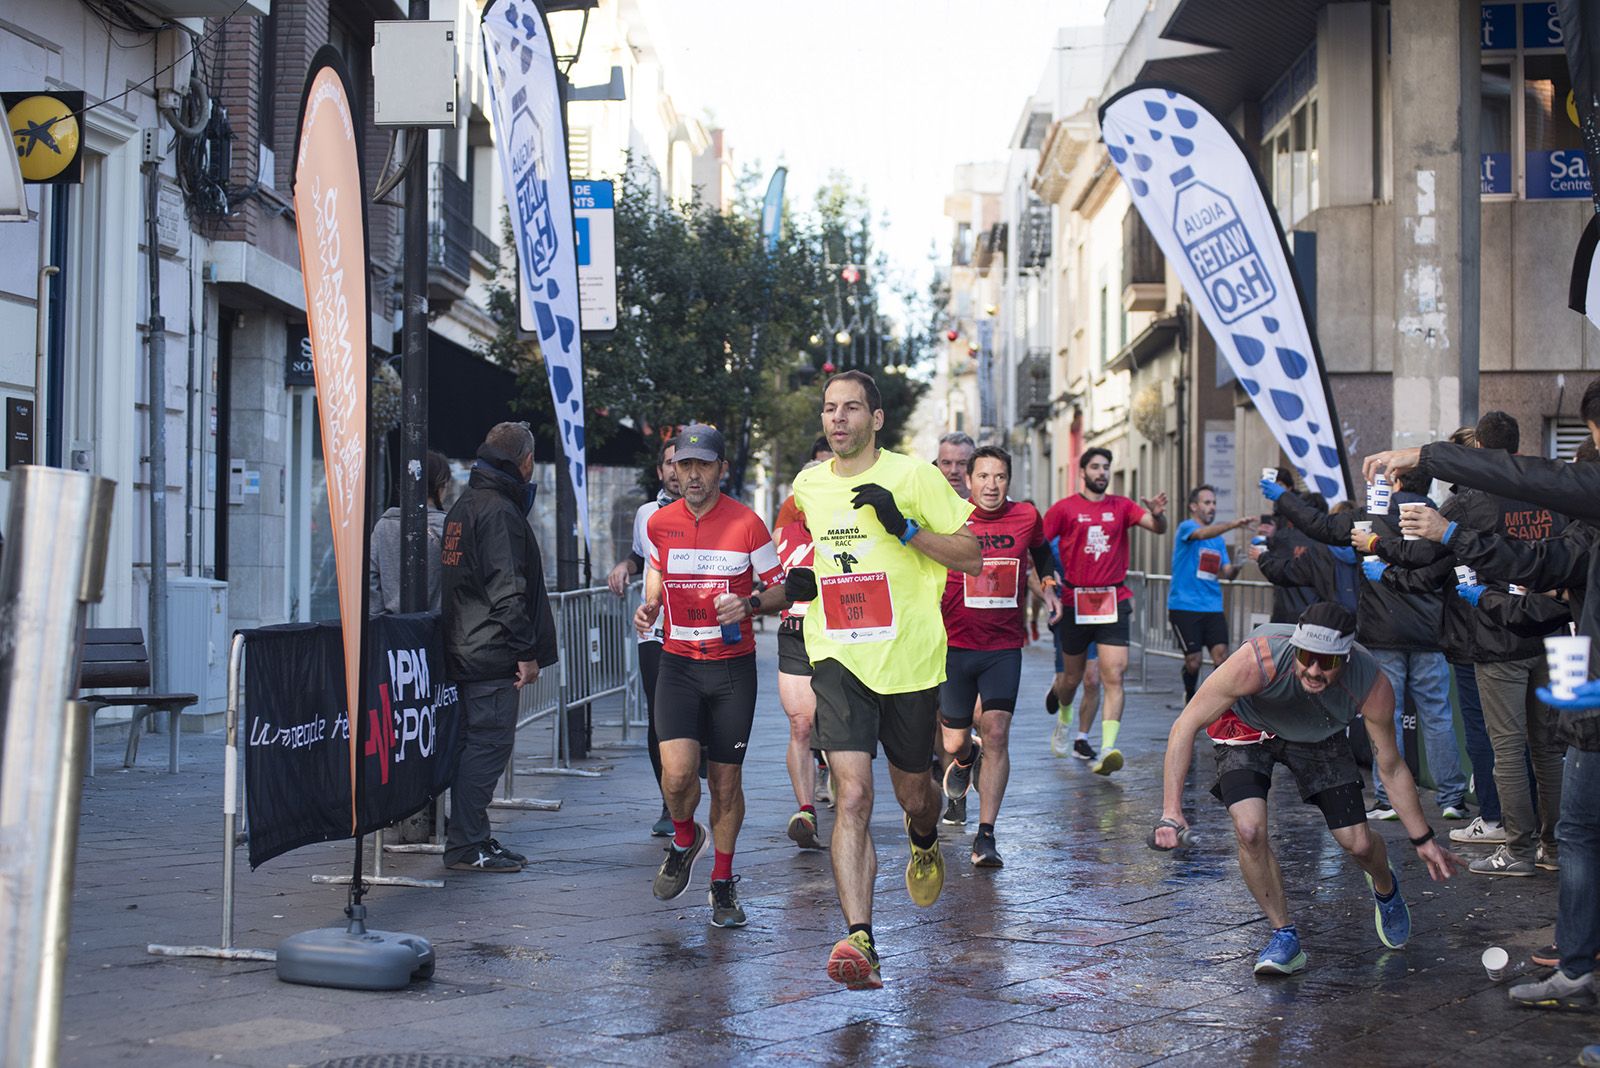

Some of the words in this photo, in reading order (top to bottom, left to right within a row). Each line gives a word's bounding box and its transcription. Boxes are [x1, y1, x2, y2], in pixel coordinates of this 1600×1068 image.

[1505, 511, 1552, 526] MITJA
[828, 526, 860, 536] MARATÓ
[1507, 523, 1552, 540] SANT
[672, 553, 690, 561] UNIÓ
[698, 554, 727, 562] CICLISTA
[697, 563, 715, 571] SANT
[854, 575, 875, 583] CUGAT
[876, 573, 885, 581] 22
[840, 592, 866, 605] DANIEL
[847, 606, 864, 621] 361
